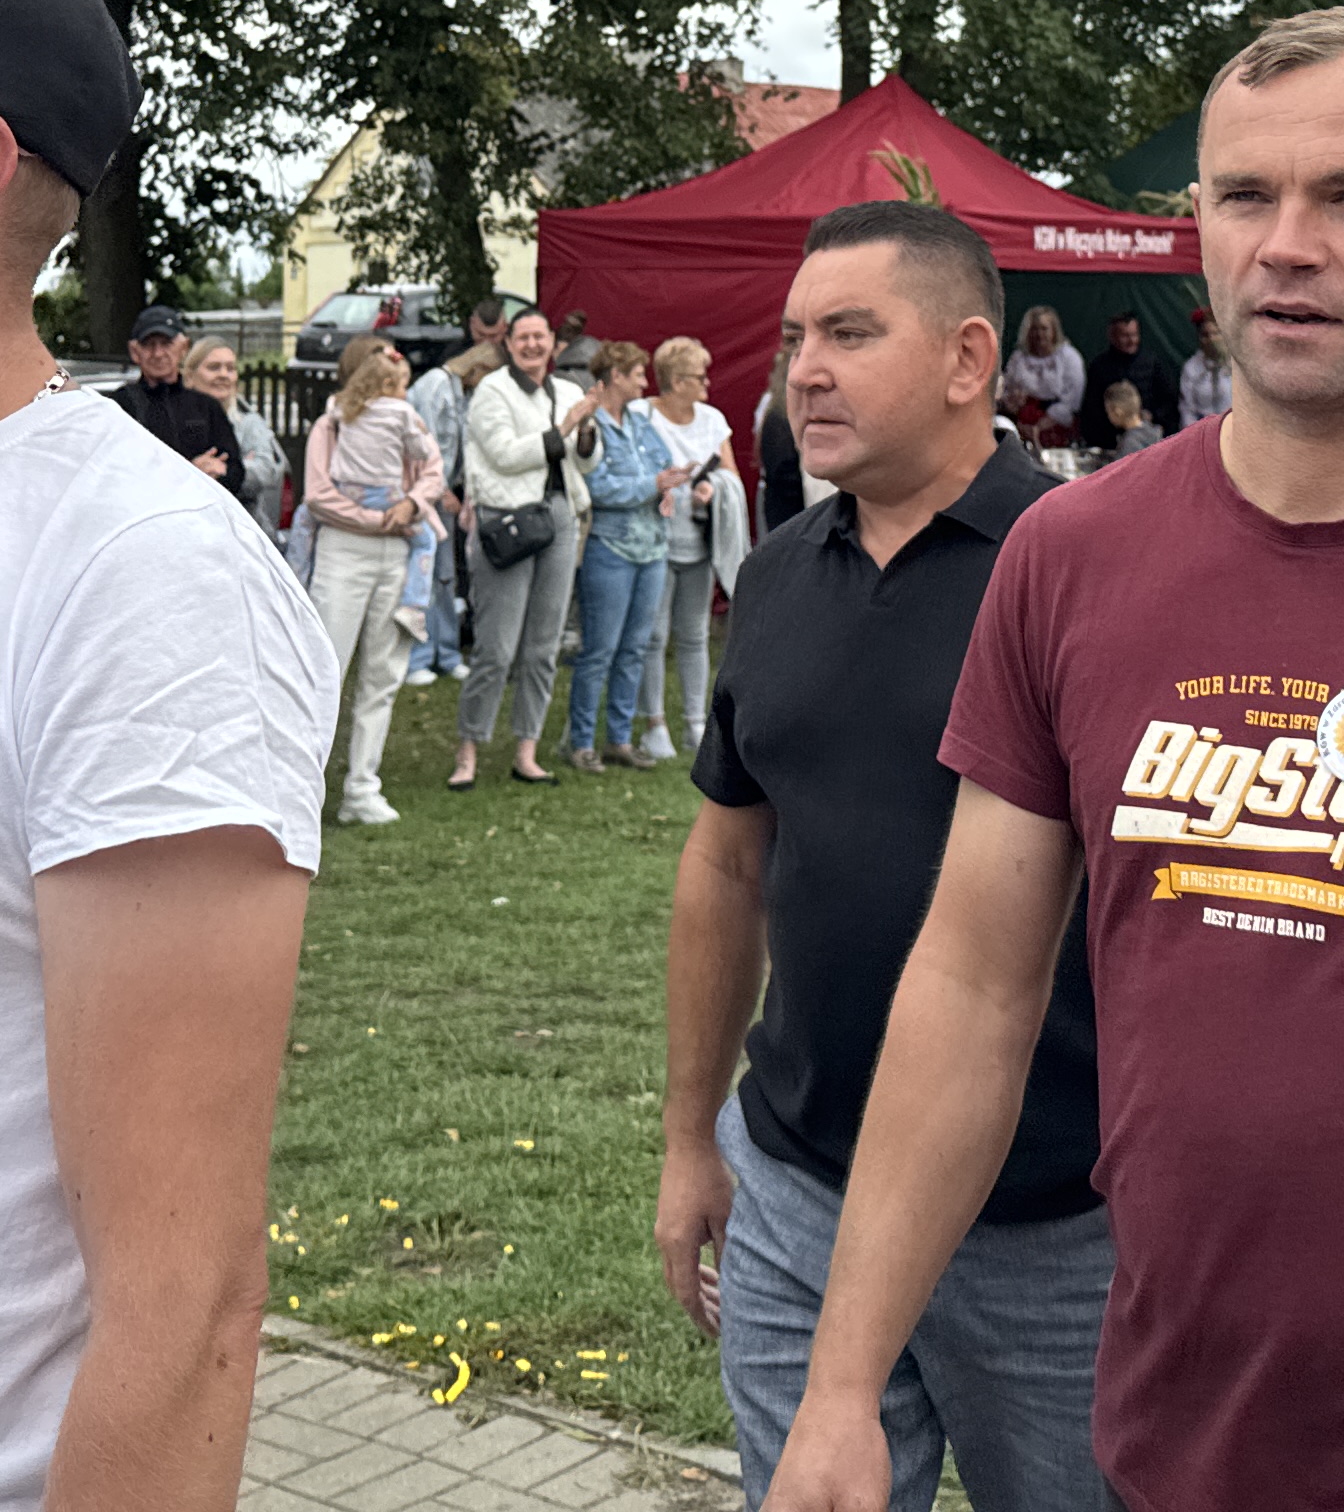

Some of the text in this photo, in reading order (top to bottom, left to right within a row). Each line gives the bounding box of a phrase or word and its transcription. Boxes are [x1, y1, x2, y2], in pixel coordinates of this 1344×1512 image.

[1175, 675, 1224, 700] YOUR
[1282, 677, 1330, 703] YOUR
[1245, 709, 1319, 731] SINCE 1979
[1203, 907, 1325, 941] BEST DENIM BRAND
